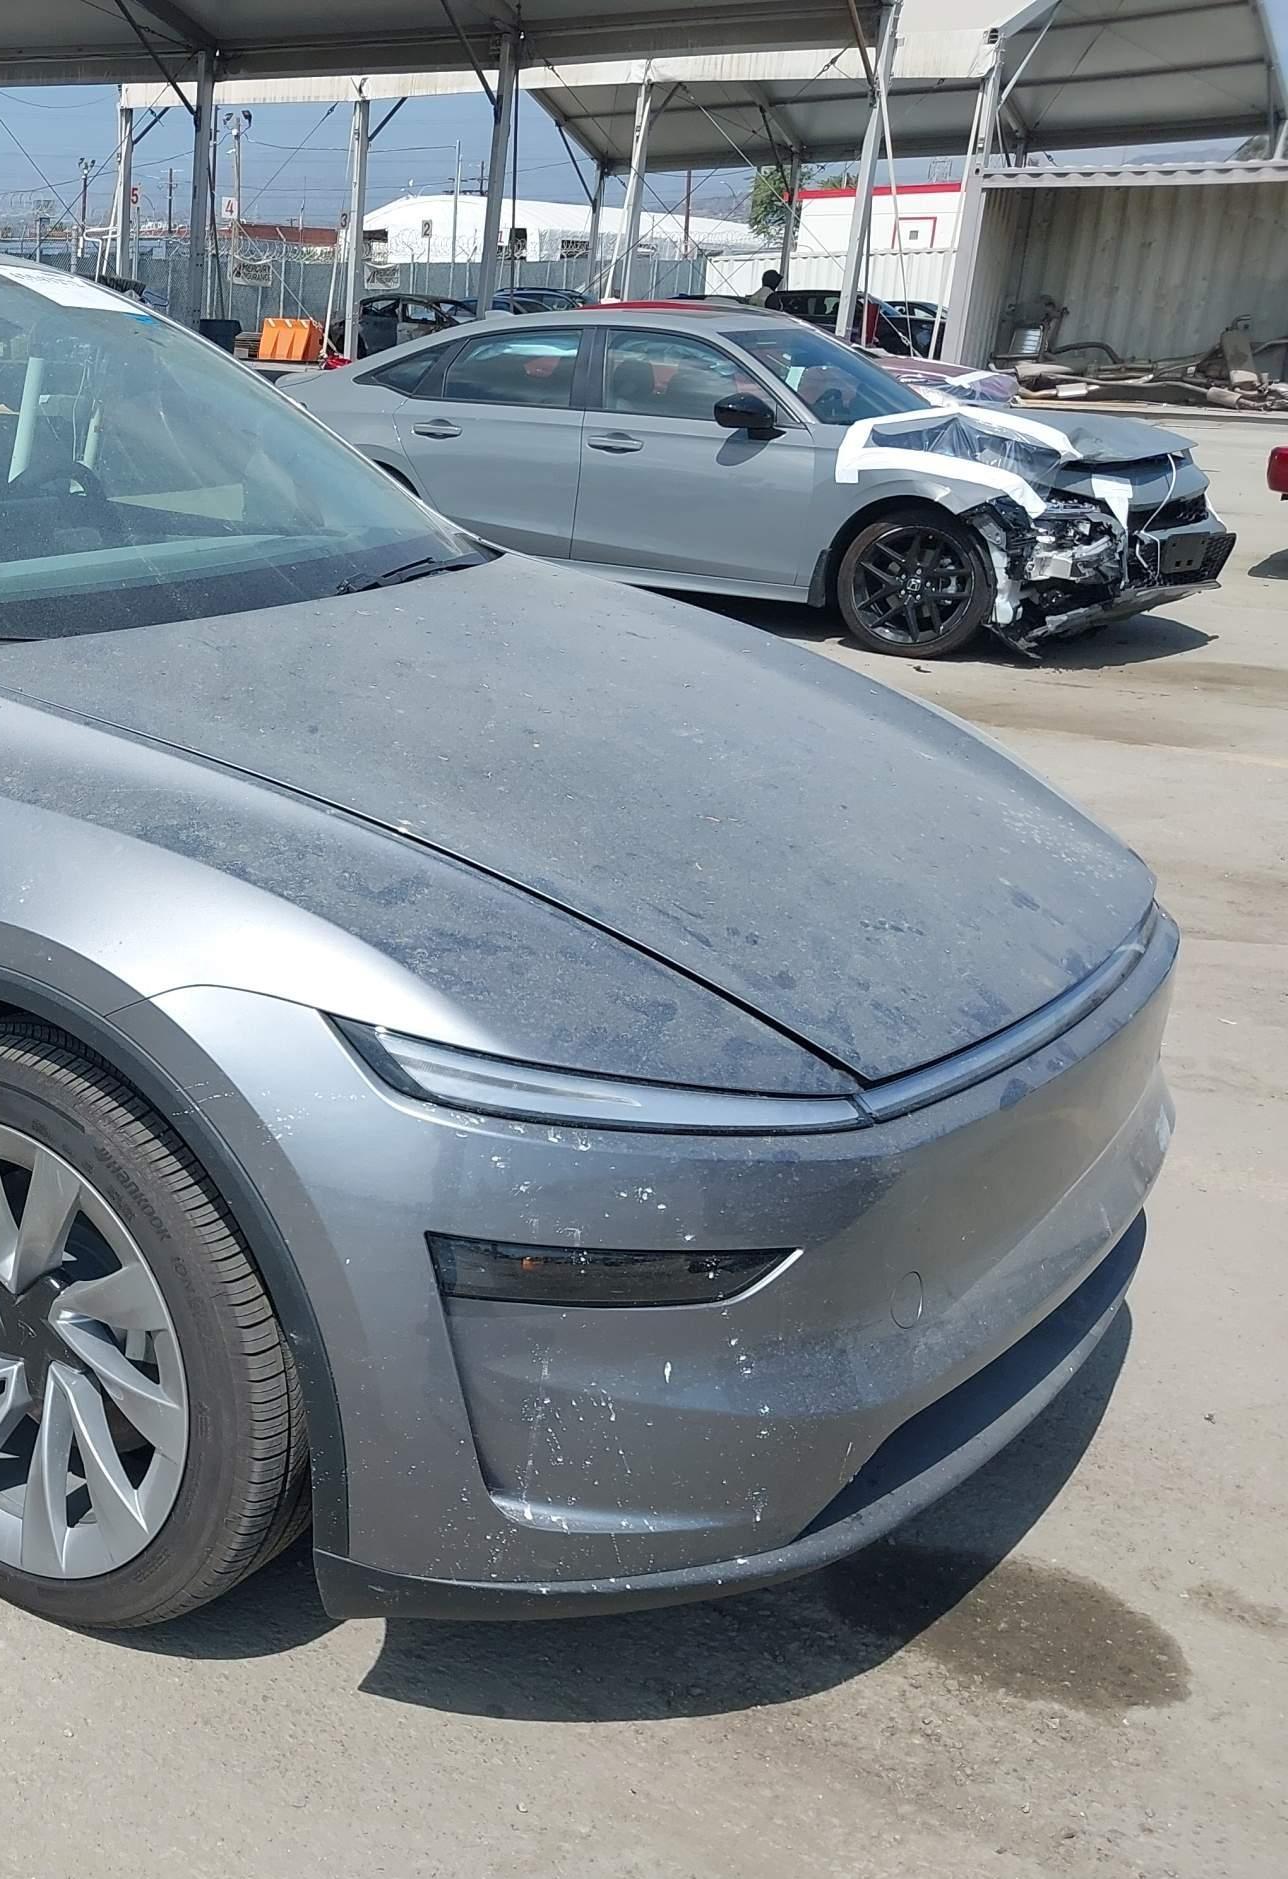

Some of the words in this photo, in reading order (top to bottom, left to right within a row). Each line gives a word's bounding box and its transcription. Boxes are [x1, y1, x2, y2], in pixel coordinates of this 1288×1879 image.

[130, 187, 139, 205] 5
[225, 199, 234, 216] 4
[340, 212, 348, 228] 3
[423, 222, 431, 237] 2
